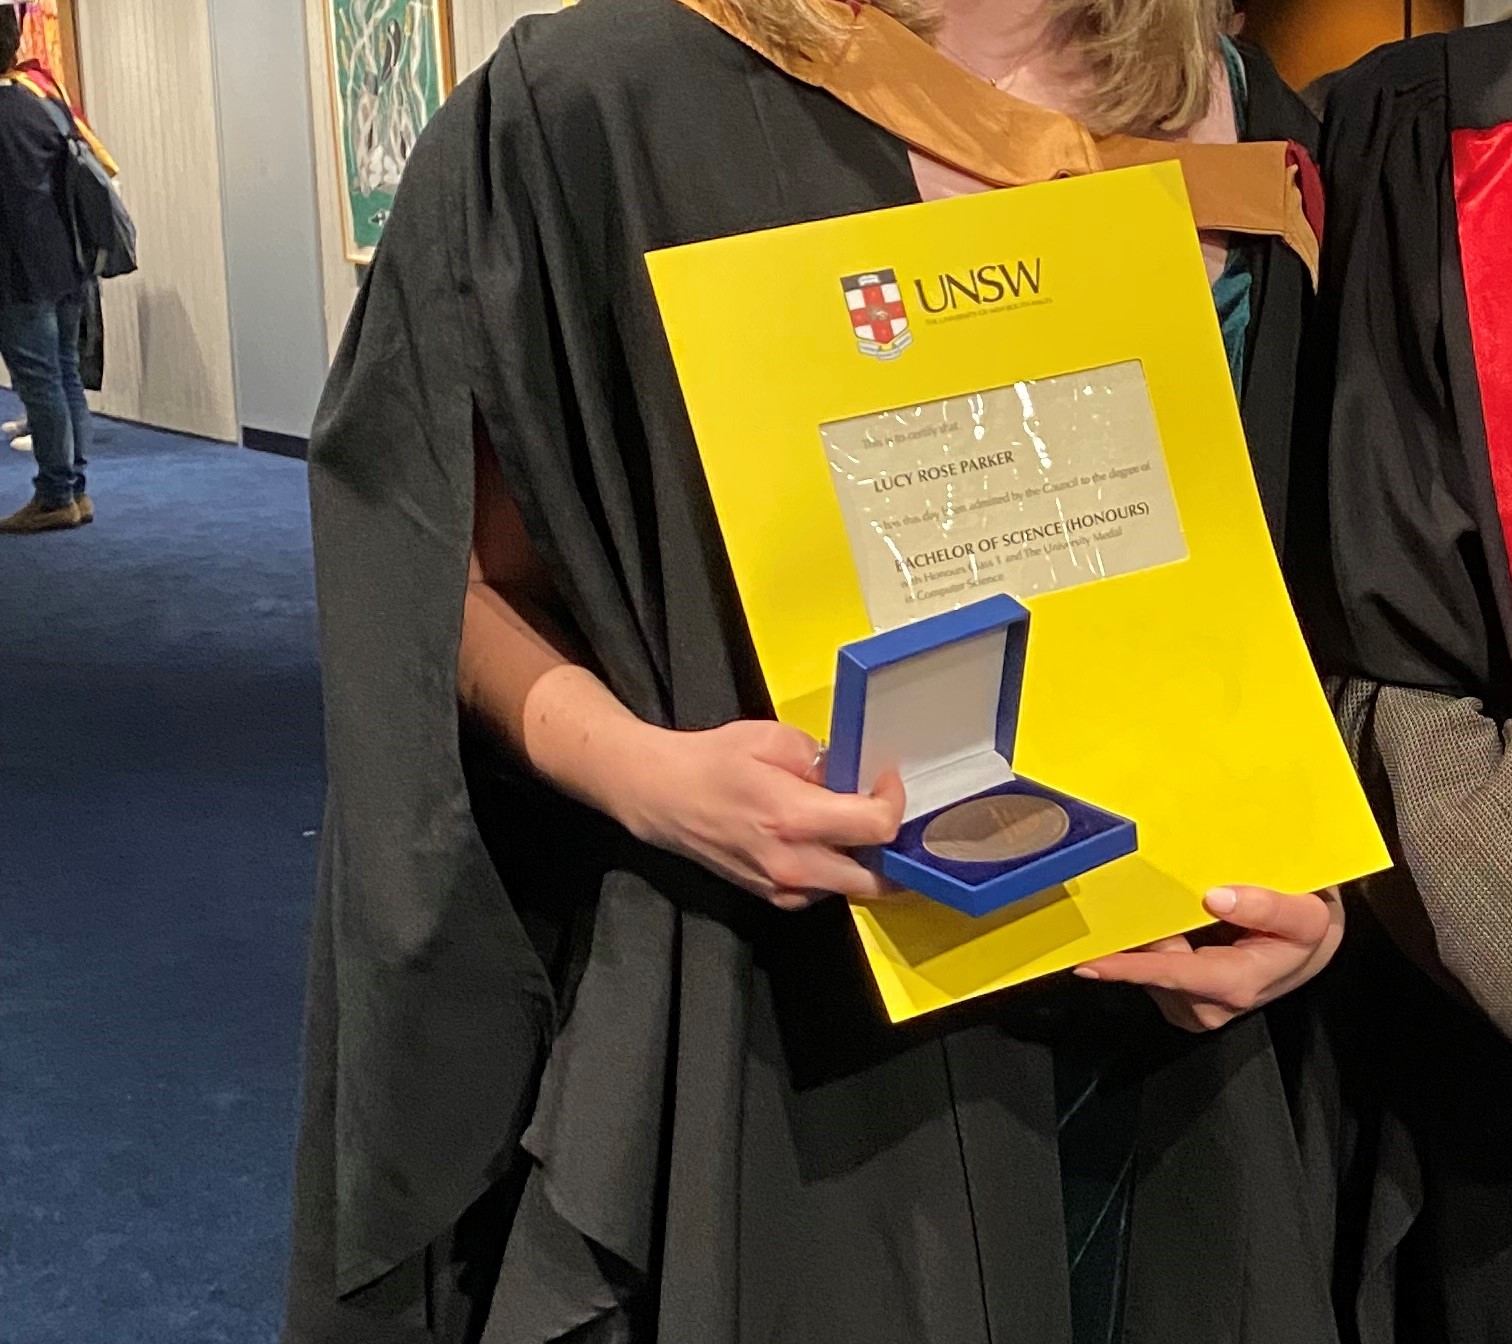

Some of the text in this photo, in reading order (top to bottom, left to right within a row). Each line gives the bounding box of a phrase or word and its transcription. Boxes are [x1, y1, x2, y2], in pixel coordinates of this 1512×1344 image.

[914, 256, 1041, 313] UNSW
[873, 450, 1015, 493] LUCY ROSE PARKER
[1011, 489, 1023, 503] by
[1043, 476, 1078, 493] Council
[894, 501, 1150, 573] BACHELOR OF SCIENCE (HONOURS)
[1005, 549, 1023, 562] and
[1024, 546, 1041, 558] The
[1093, 525, 1122, 541] Medal
